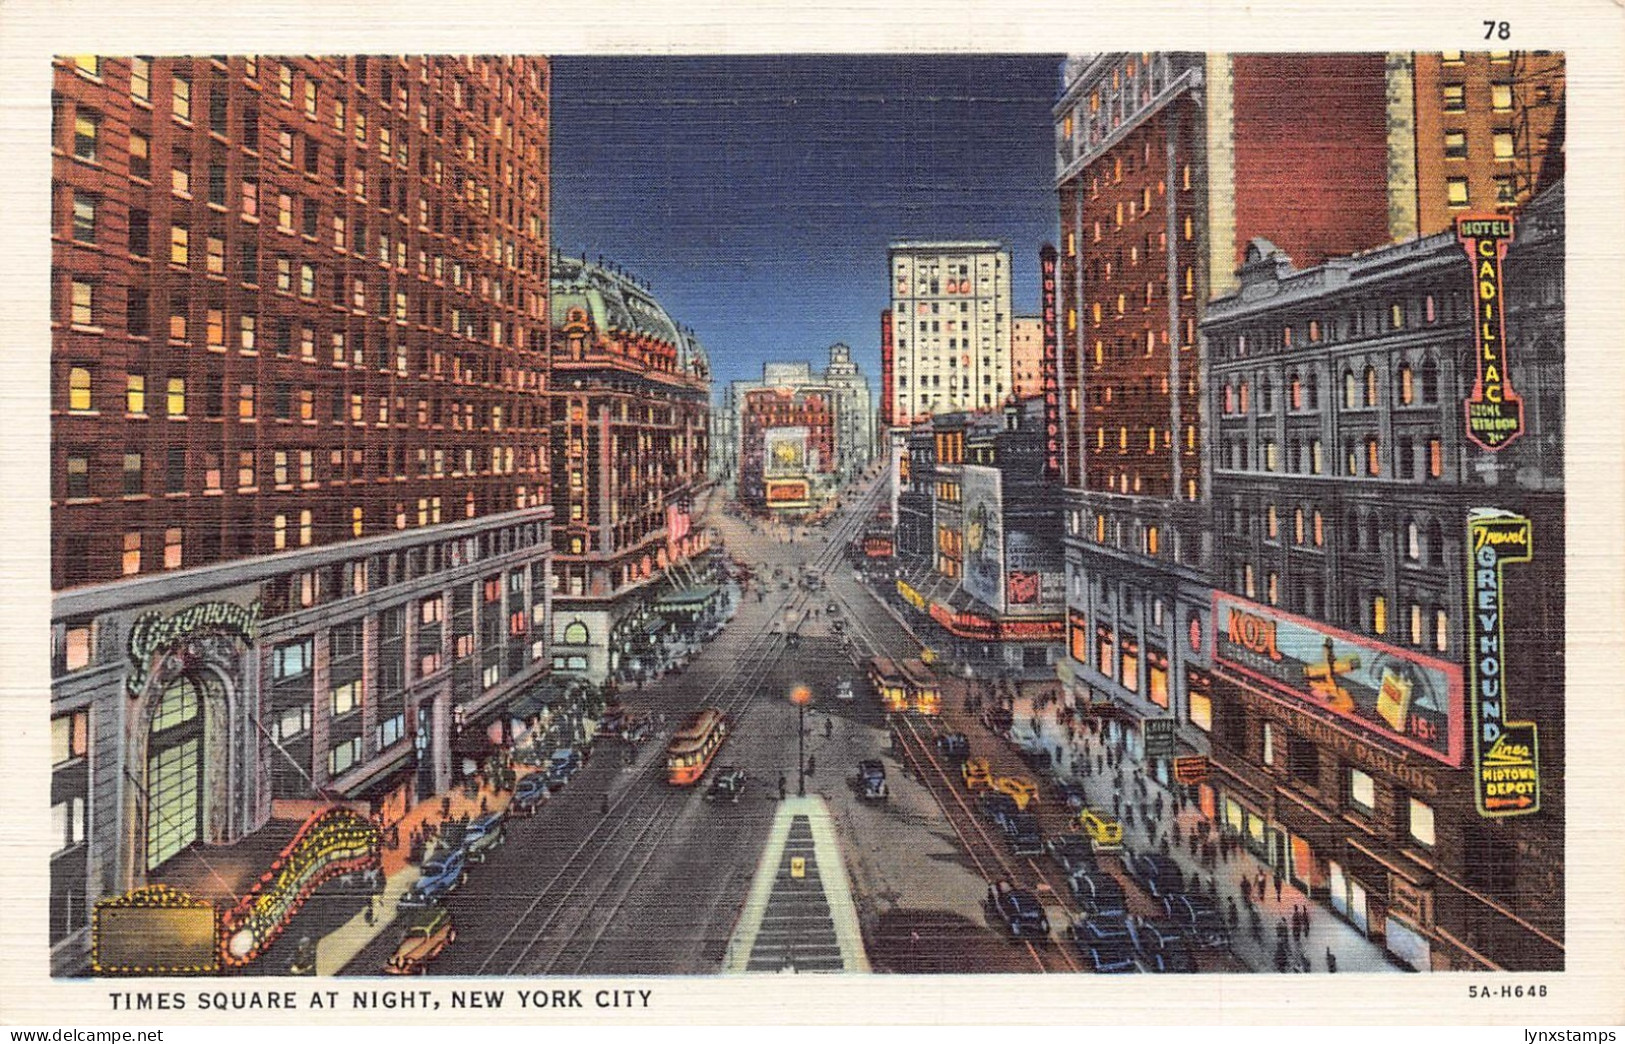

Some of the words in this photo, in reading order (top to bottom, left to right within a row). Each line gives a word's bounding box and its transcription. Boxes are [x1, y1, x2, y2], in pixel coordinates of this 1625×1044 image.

[1483, 20, 1511, 40] 78
[1461, 221, 1510, 236] HOTEL
[1479, 240, 1502, 403] CADILLAC
[1474, 526, 1526, 552] Travel
[1228, 607, 1282, 662] KOOL
[1477, 545, 1500, 742] GREYHOUND
[1484, 733, 1530, 762] Lines
[1482, 768, 1535, 781] MIDTOWN
[1487, 782, 1534, 796] DEPOT
[109, 992, 187, 1011] TIMES
[198, 992, 297, 1011] SQUARE
[310, 991, 340, 1009] AT
[353, 991, 440, 1011] NIGHT,
[451, 991, 504, 1009] NEW
[517, 990, 584, 1009] YORK
[595, 990, 653, 1009] CITY
